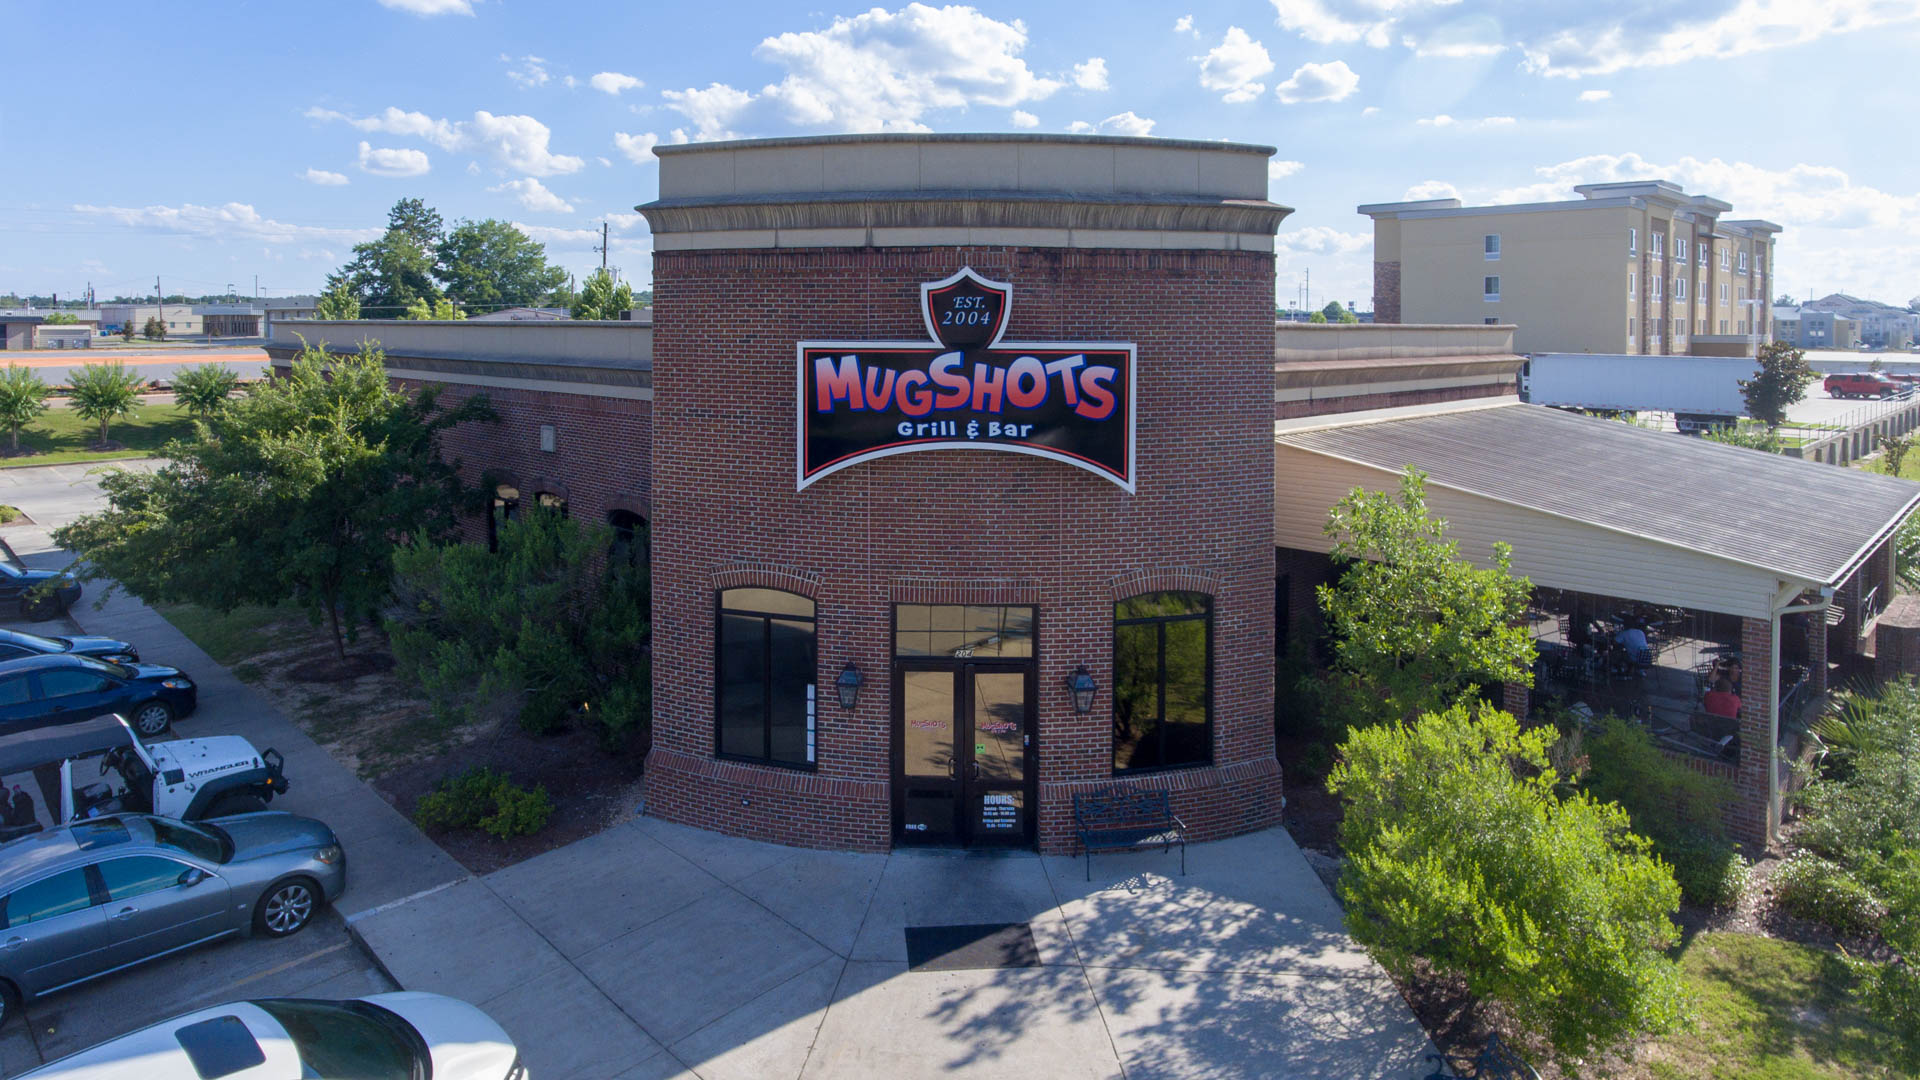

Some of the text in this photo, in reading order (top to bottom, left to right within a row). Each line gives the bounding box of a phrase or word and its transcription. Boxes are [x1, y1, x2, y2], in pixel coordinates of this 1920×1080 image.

[953, 296, 986, 309] EST.
[942, 311, 991, 325] 2004
[897, 420, 1033, 440] Grill & Bar
[188, 760, 249, 778] WRANGLER
